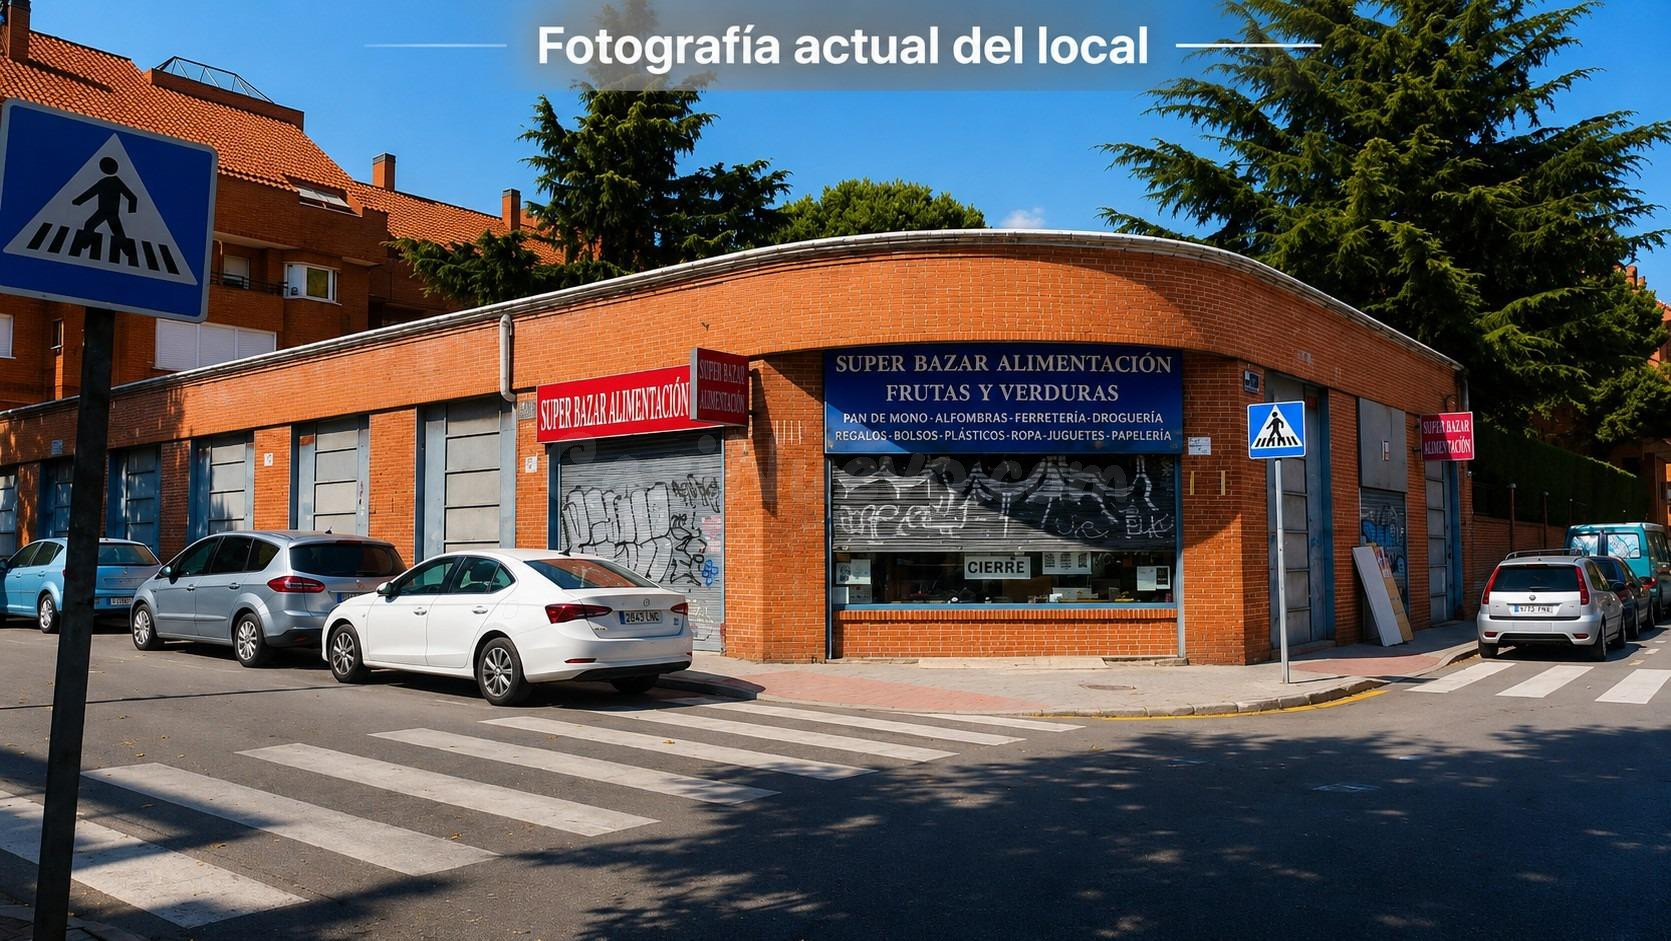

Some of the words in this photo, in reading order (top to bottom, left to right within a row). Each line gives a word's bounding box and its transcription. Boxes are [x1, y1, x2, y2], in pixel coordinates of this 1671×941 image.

[700, 359, 721, 382] SUPER
[723, 363, 745, 385] BAZAR
[836, 354, 906, 373] SUPER
[914, 354, 989, 373] BAZAR
[996, 352, 1172, 374] ALIMENTACIÓN
[886, 384, 970, 402] FRUTAS
[978, 384, 993, 402] Y
[1000, 384, 1119, 402] VERDURAS
[541, 397, 572, 431] SUPER
[573, 393, 607, 428] BAZAR
[608, 376, 690, 423] ALIMENTACIÓN
[843, 412, 867, 424] PAN
[871, 412, 886, 424] DE
[1423, 420, 1446, 434] SUPER
[1446, 419, 1470, 433] BAZAR
[968, 561, 1025, 574] CIERRE
